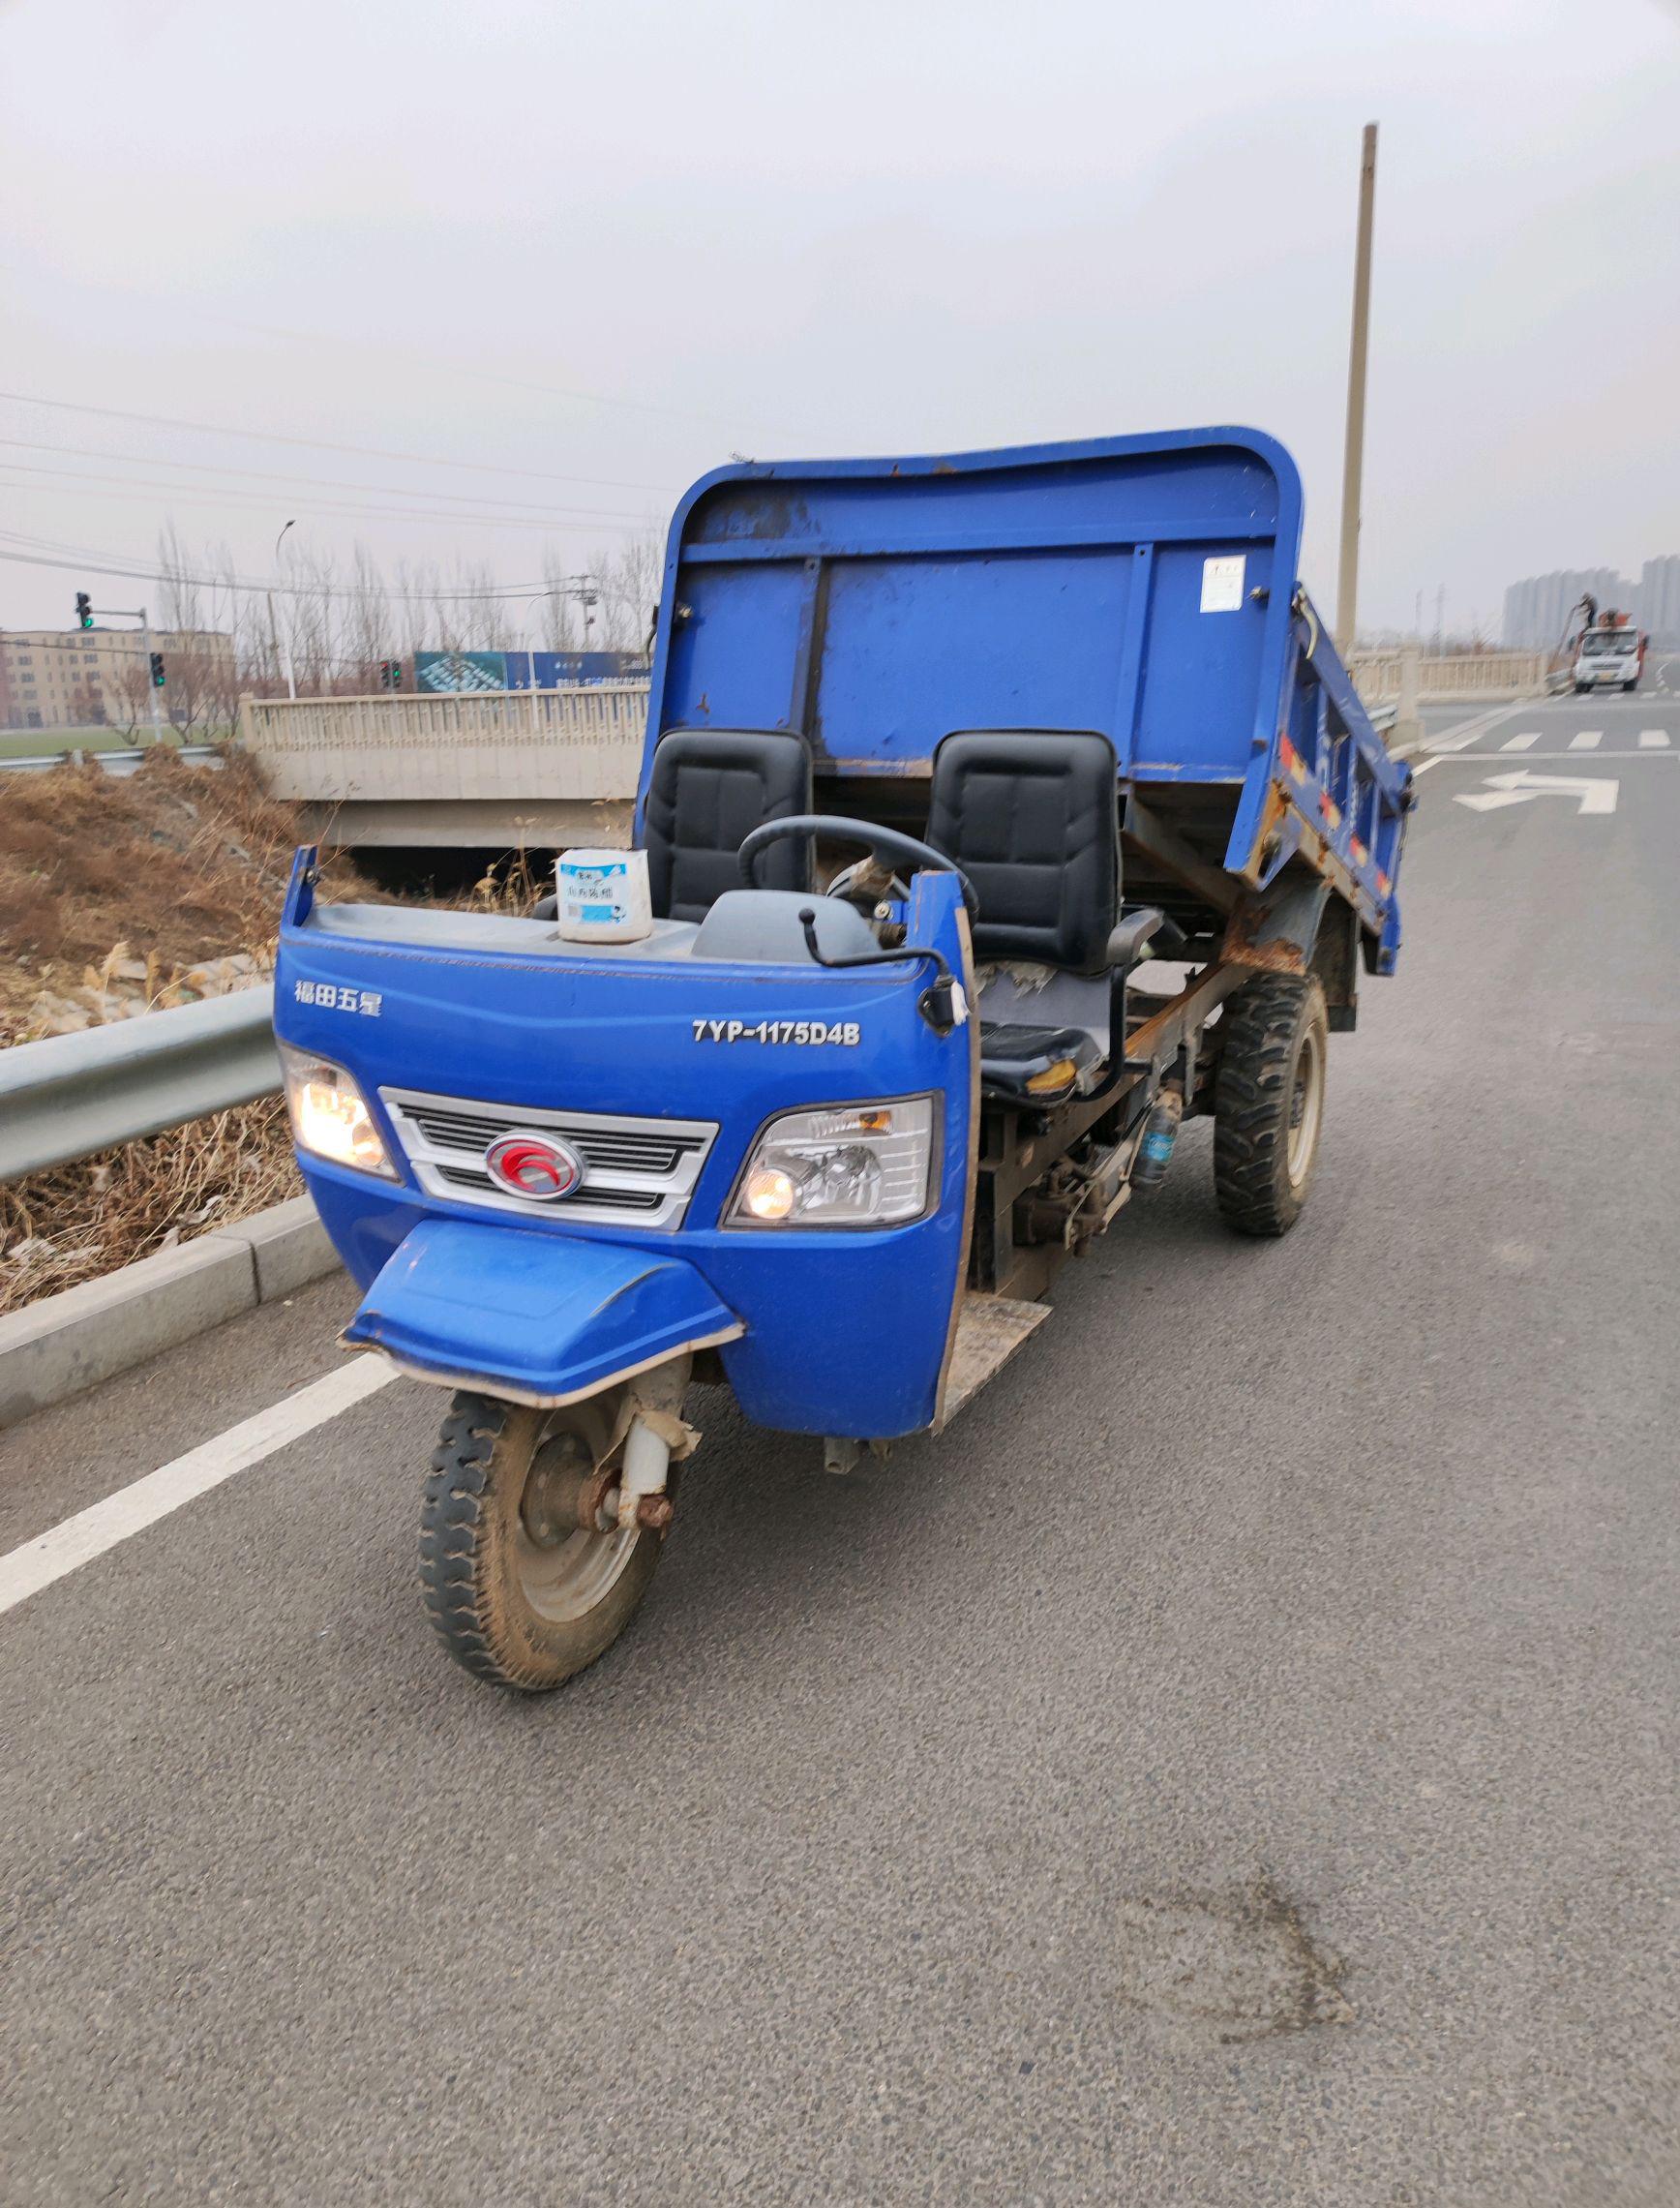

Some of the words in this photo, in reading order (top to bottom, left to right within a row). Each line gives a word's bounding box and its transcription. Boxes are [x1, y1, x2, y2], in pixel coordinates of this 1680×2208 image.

[294, 980, 383, 1018] 福田五星
[692, 1019, 861, 1046] 7YP-1175D4B
